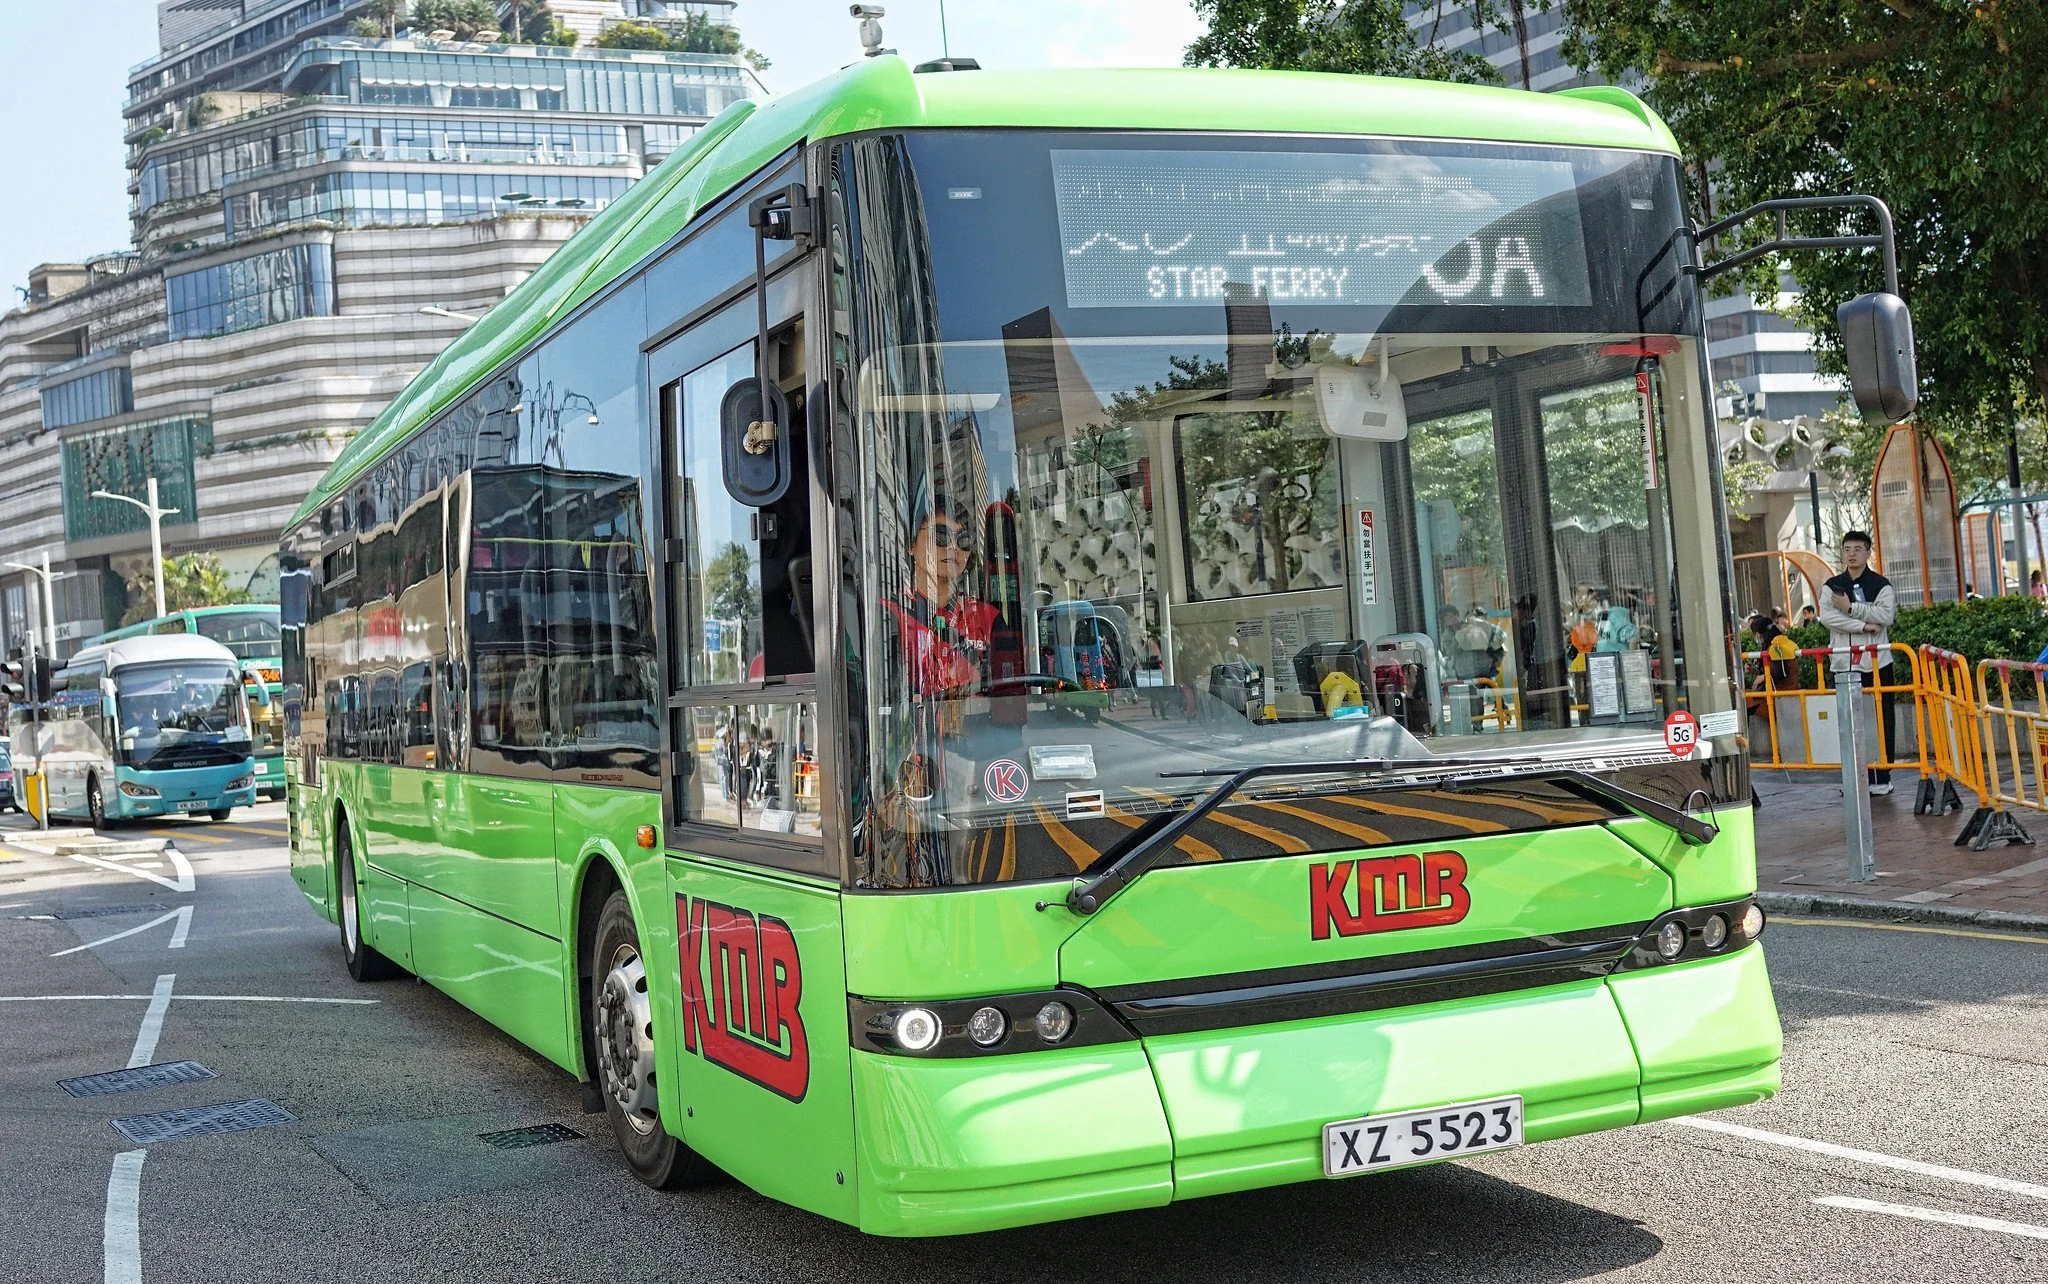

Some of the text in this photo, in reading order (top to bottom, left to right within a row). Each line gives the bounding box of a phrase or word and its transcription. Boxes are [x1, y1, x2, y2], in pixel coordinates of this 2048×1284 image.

[1148, 264, 1350, 298] STAR FERRY
[1673, 726, 1690, 743] 5G
[994, 765, 1023, 797] K
[1309, 849, 1472, 942] KMB
[675, 891, 810, 1105] KMB
[1339, 1104, 1513, 1169] XZ 5523
